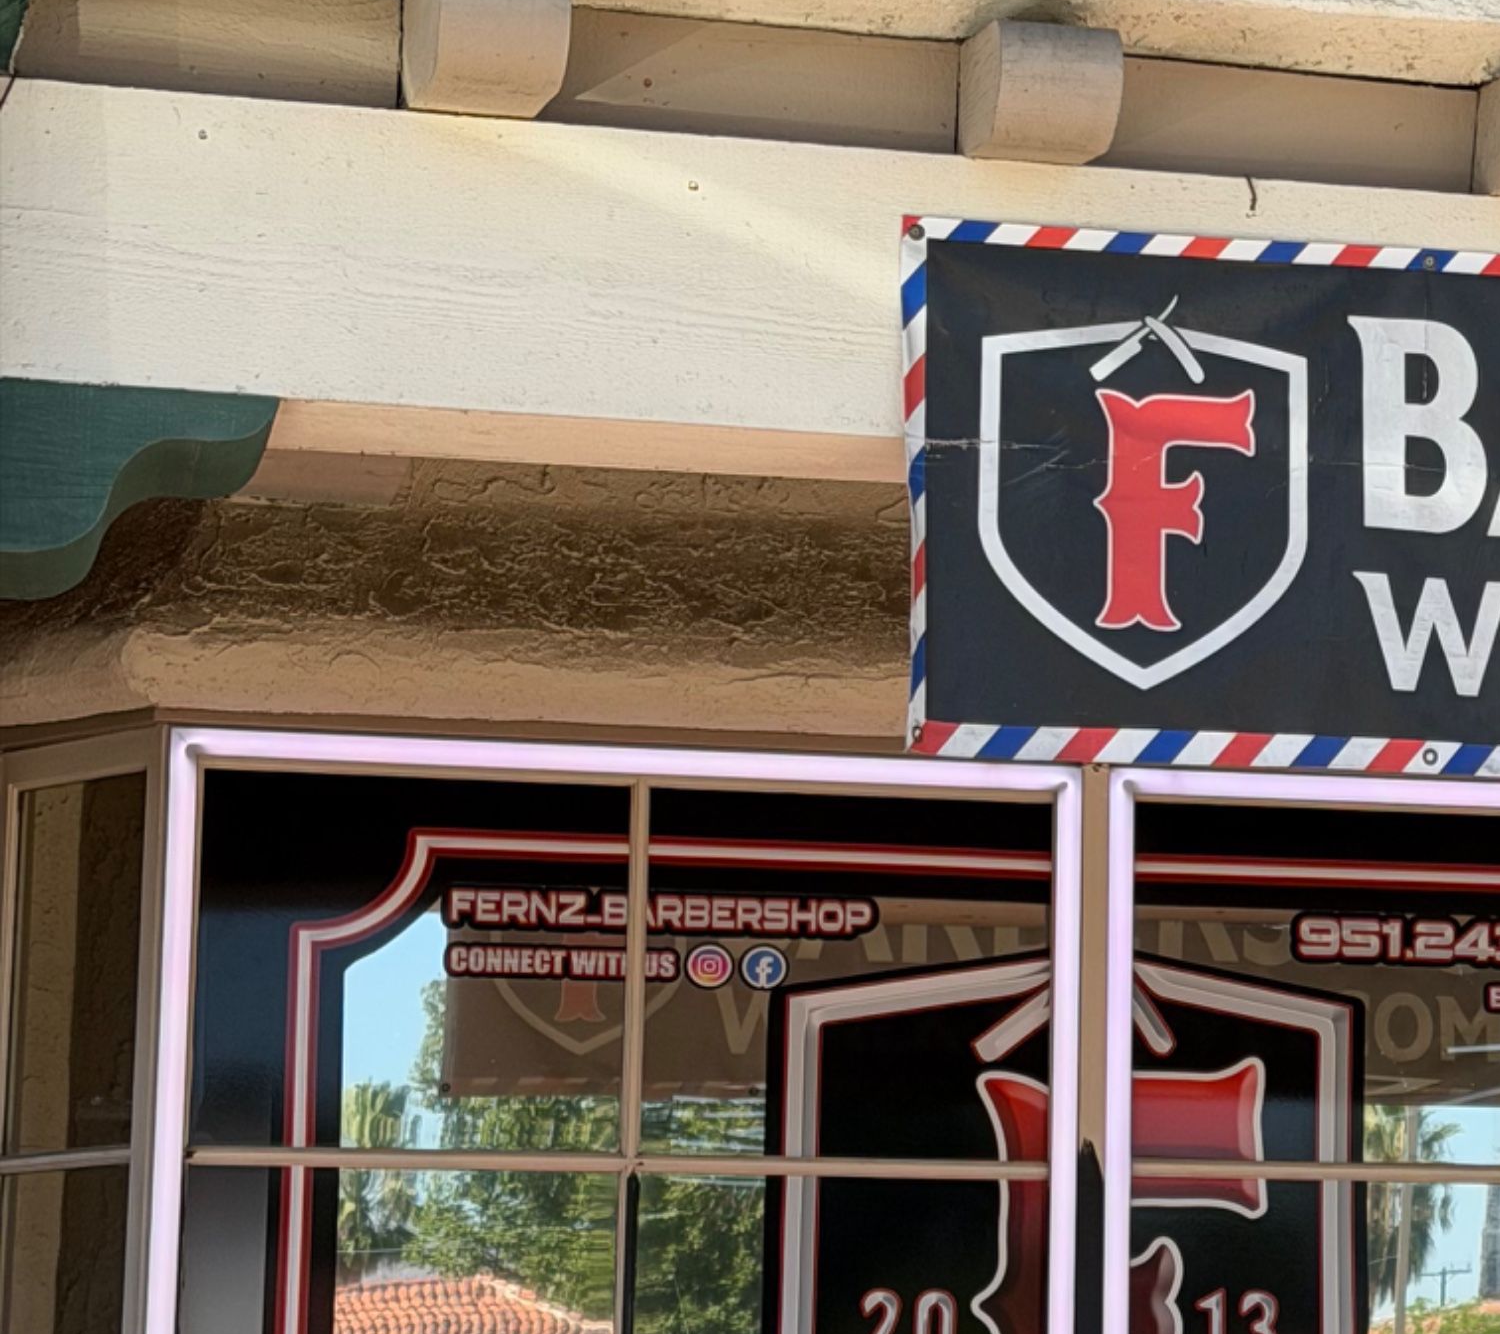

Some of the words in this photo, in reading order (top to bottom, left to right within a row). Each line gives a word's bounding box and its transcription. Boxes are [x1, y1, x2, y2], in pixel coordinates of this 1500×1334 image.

[1093, 385, 1258, 633] F
[452, 945, 568, 976] CONNECT
[645, 952, 677, 978] US
